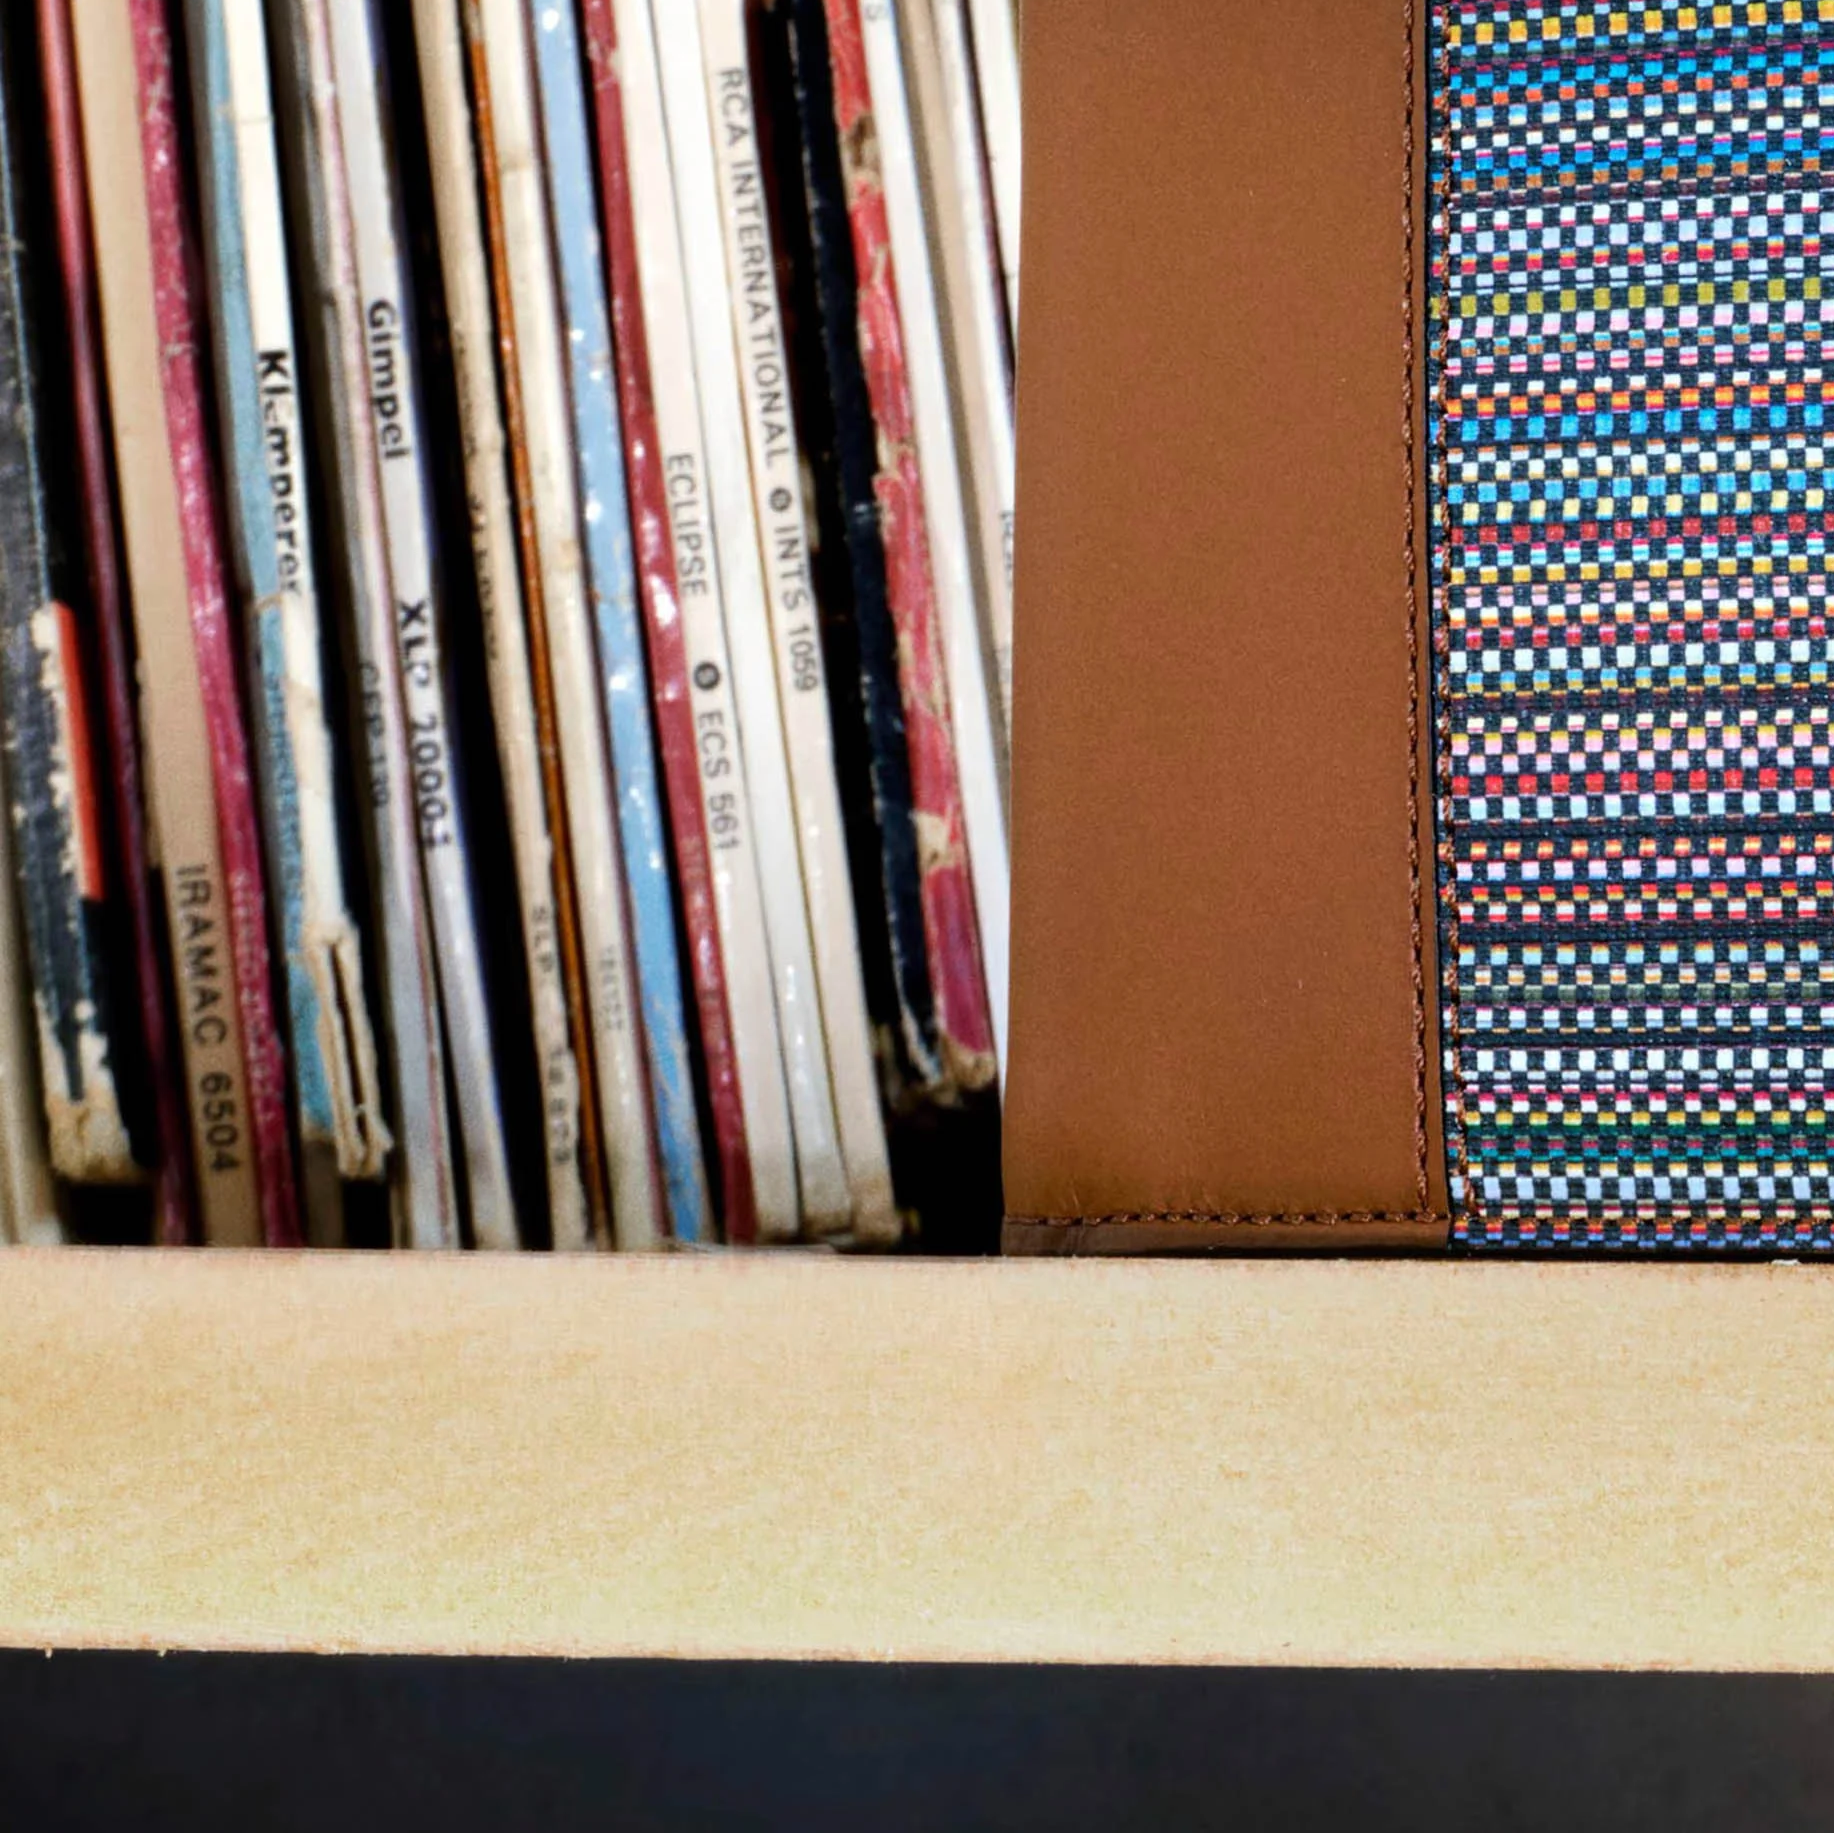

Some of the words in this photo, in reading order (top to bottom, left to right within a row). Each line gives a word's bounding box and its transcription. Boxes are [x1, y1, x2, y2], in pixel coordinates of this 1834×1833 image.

[715, 65, 752, 148] RCA
[726, 158, 792, 470] INTERNATIONAL
[358, 298, 410, 461] Gimpel
[663, 452, 710, 600] ECLIPSE
[772, 523, 810, 613] INTS
[784, 622, 820, 695] 1059
[695, 708, 732, 782] ECS
[706, 790, 741, 853] 561
[172, 863, 227, 1049] IRAMAC
[197, 1069, 244, 1175] 6504
